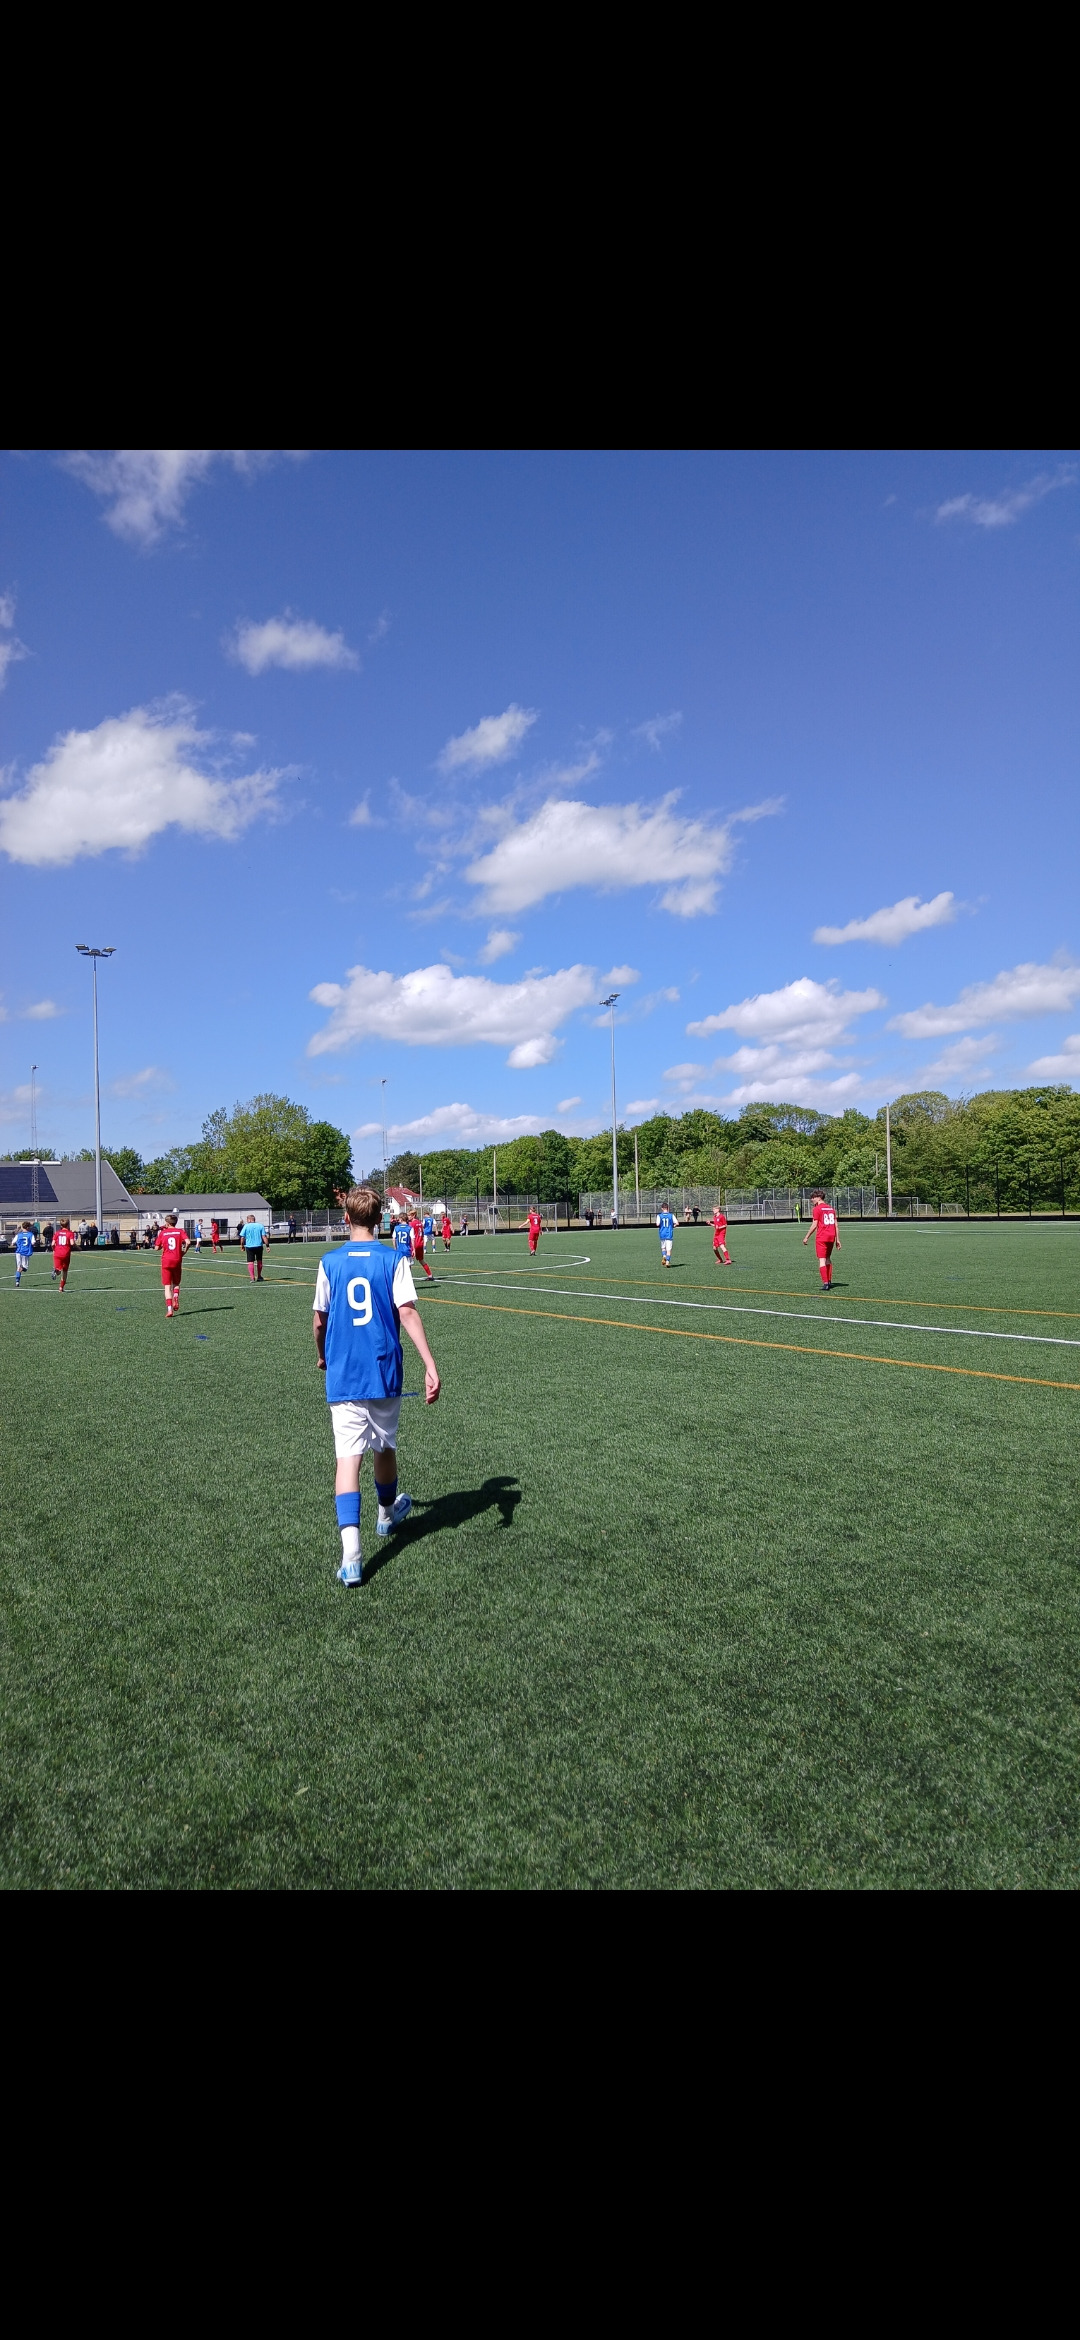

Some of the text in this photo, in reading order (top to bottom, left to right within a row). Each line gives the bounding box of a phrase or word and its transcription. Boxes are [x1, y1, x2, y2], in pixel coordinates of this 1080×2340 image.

[662, 1218, 669, 1228] 11
[823, 1213, 835, 1225] 88
[22, 1236, 28, 1246] 3
[58, 1235, 67, 1246] 10
[167, 1237, 176, 1250] 9
[397, 1231, 408, 1244] 12
[346, 1276, 373, 1326] 9
